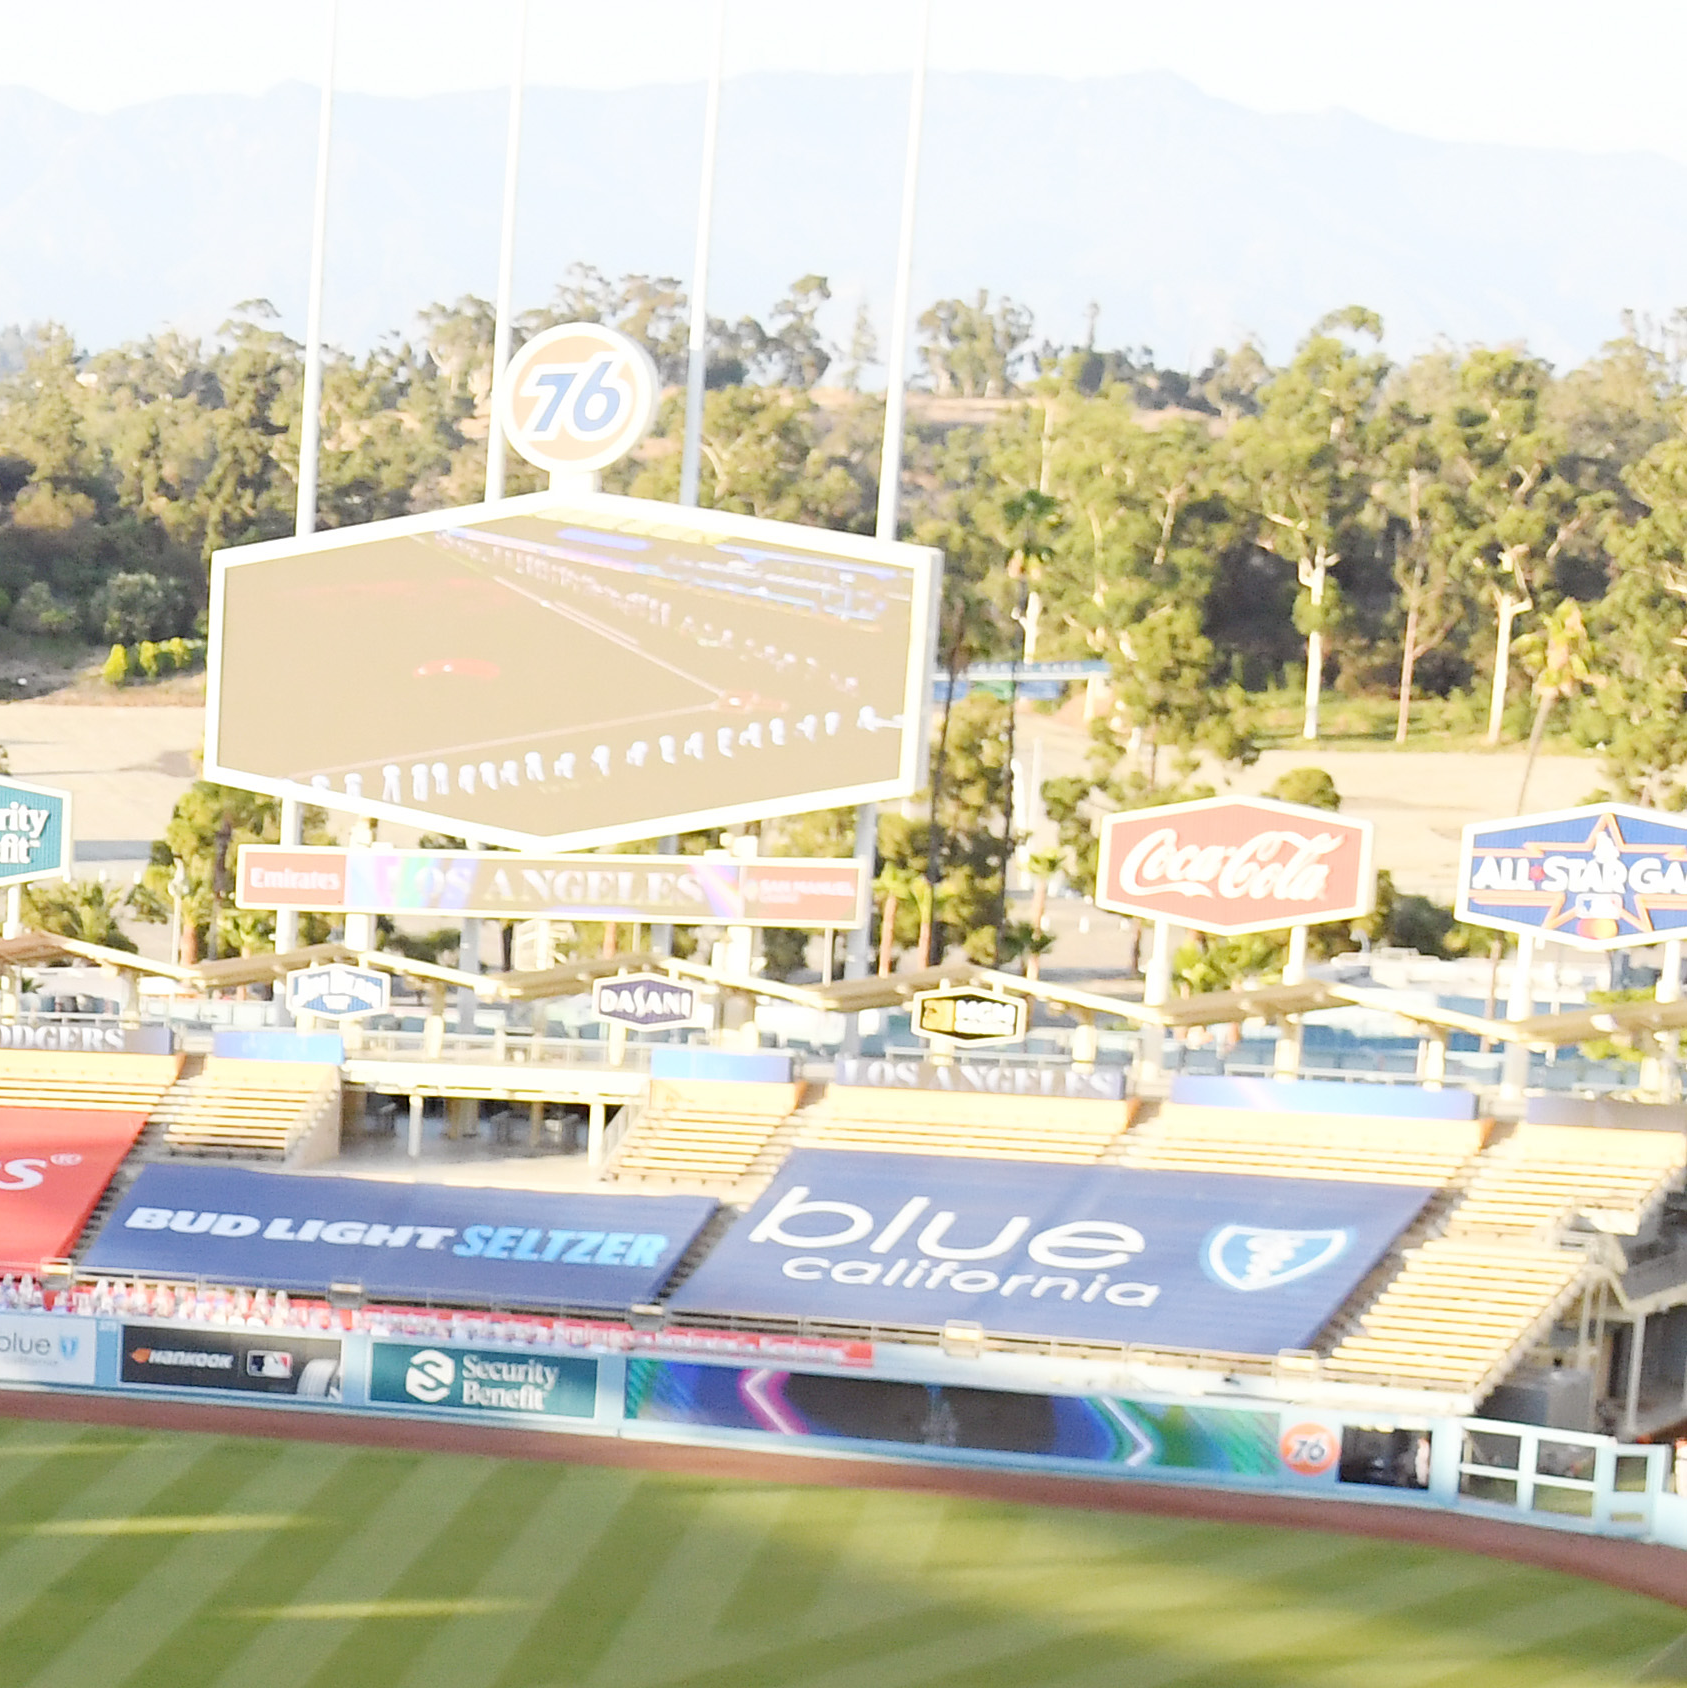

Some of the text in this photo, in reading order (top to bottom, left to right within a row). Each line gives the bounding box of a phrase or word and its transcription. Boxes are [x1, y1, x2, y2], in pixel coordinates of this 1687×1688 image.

[529, 356, 625, 437] 76
[250, 867, 340, 890] Emirates
[483, 868, 704, 903] ANGELES
[1472, 856, 1536, 890] ALL
[1541, 856, 1626, 893] STAR
[600, 986, 692, 1018] DASANI
[124, 1207, 669, 1269] BUD LIGHT SELTZER
[748, 1186, 1148, 1270] blue
[781, 1253, 1161, 1309] california
[461, 1354, 557, 1390] Security
[462, 1380, 545, 1410] Benefit
[1287, 1432, 1330, 1465] 76
